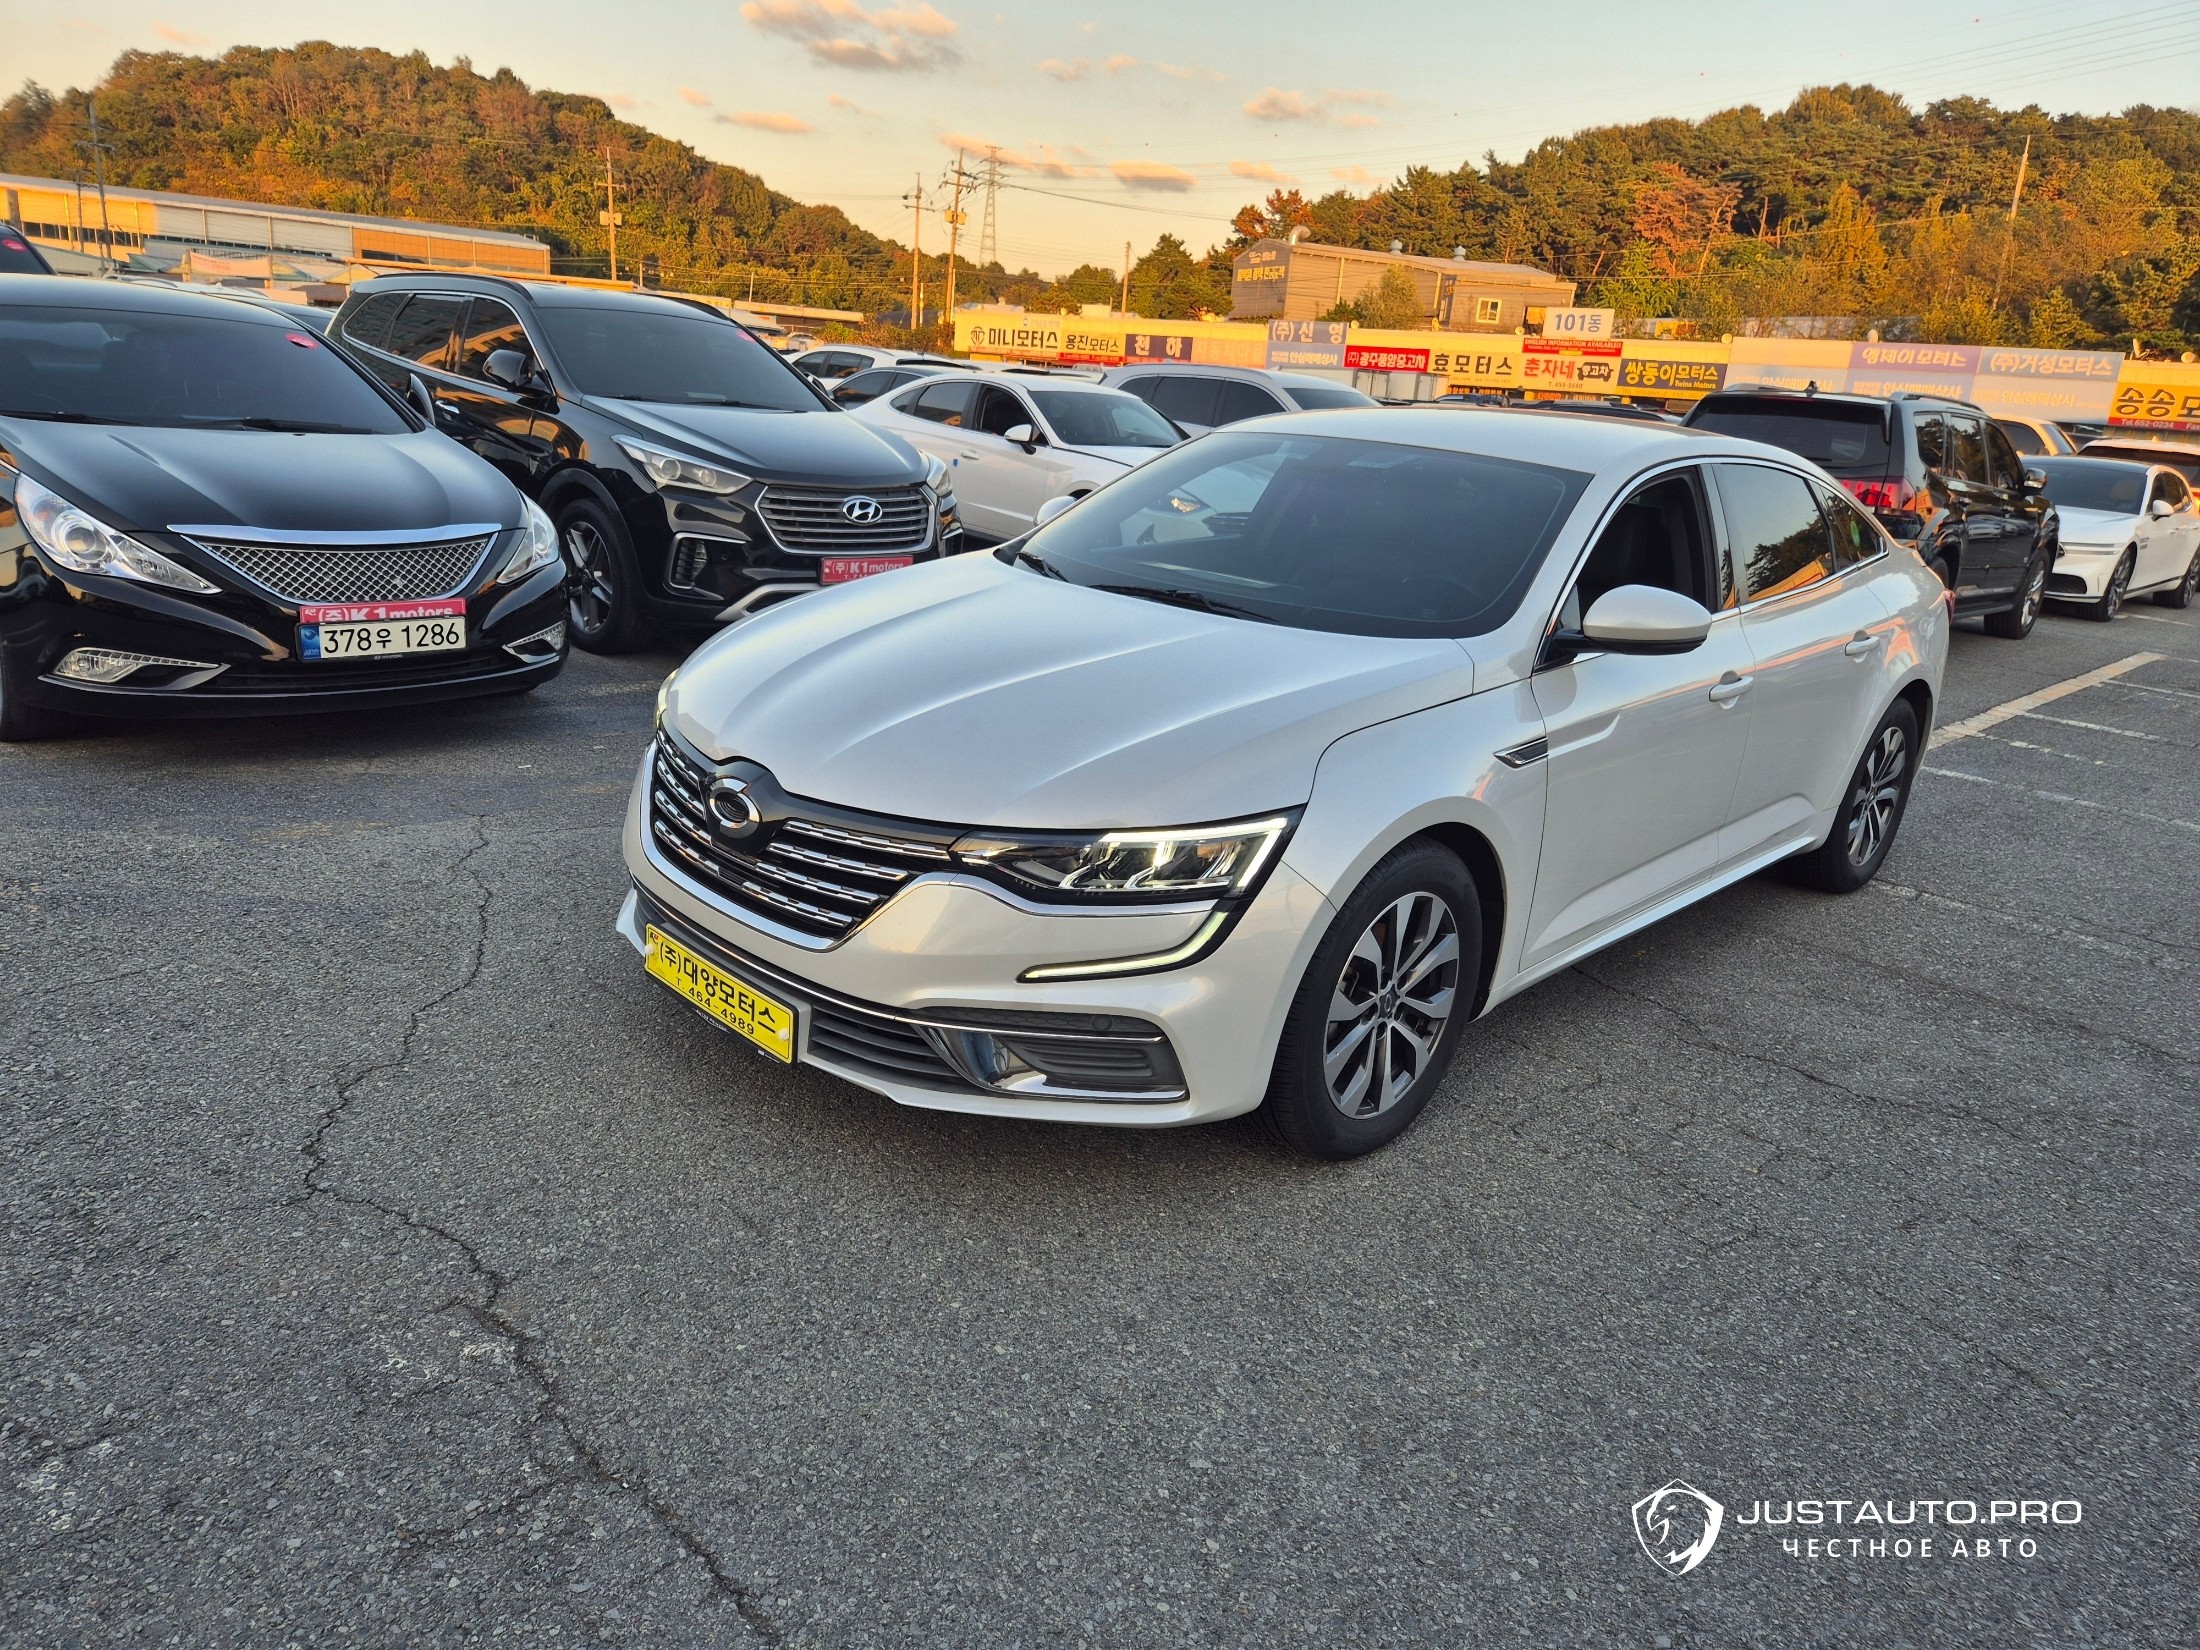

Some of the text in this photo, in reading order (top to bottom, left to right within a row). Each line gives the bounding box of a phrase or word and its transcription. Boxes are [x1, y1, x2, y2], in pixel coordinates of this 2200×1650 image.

[1554, 313, 1602, 333] 101동
[988, 328, 1059, 350] 미니모터스
[1432, 353, 1513, 377] 효모터스
[1524, 358, 1576, 380] 춘자네
[1581, 364, 1610, 377] 중고차
[1675, 380, 1716, 390] Twins Motors
[323, 622, 460, 654] 378우 1286
[660, 941, 776, 1034] (주)대양모터스
[688, 985, 755, 1035] 464-4989
